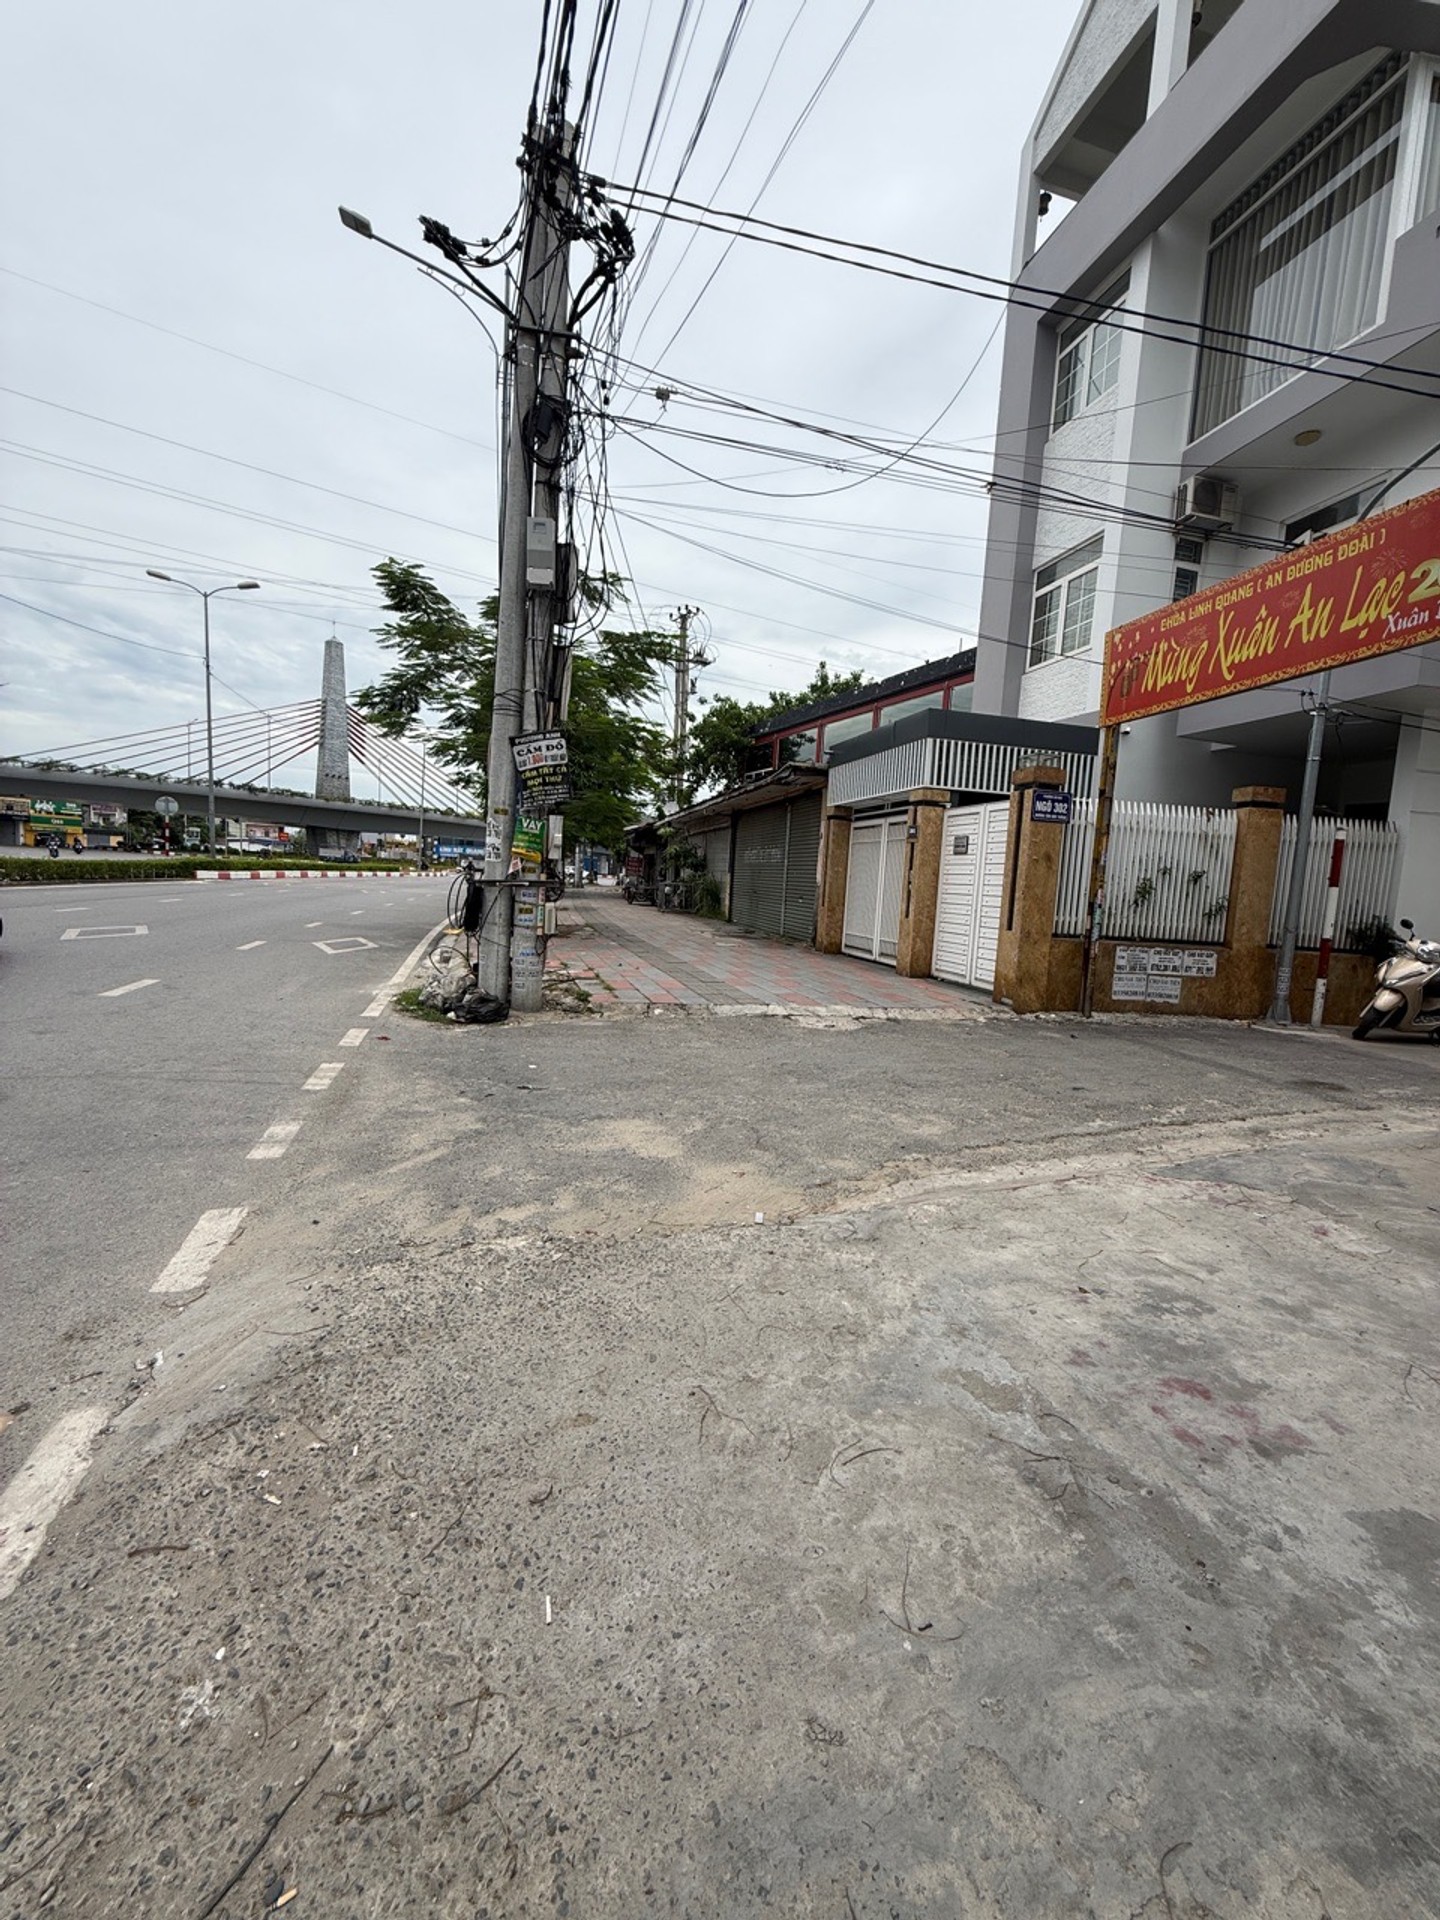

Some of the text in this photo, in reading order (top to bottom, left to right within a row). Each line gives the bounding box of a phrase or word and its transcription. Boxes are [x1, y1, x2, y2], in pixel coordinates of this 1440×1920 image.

[1189, 600, 1213, 620] LINH
[1215, 582, 1254, 611] QUANG
[1265, 570, 1283, 590] AN
[1141, 638, 1209, 693] Mừng
[1208, 604, 1280, 680] Xuân
[1284, 582, 1336, 649] An
[1339, 565, 1406, 640] Lạc
[1382, 606, 1429, 639] Xuân
[521, 816, 543, 830] VAY
[1053, 802, 1068, 814] 302
